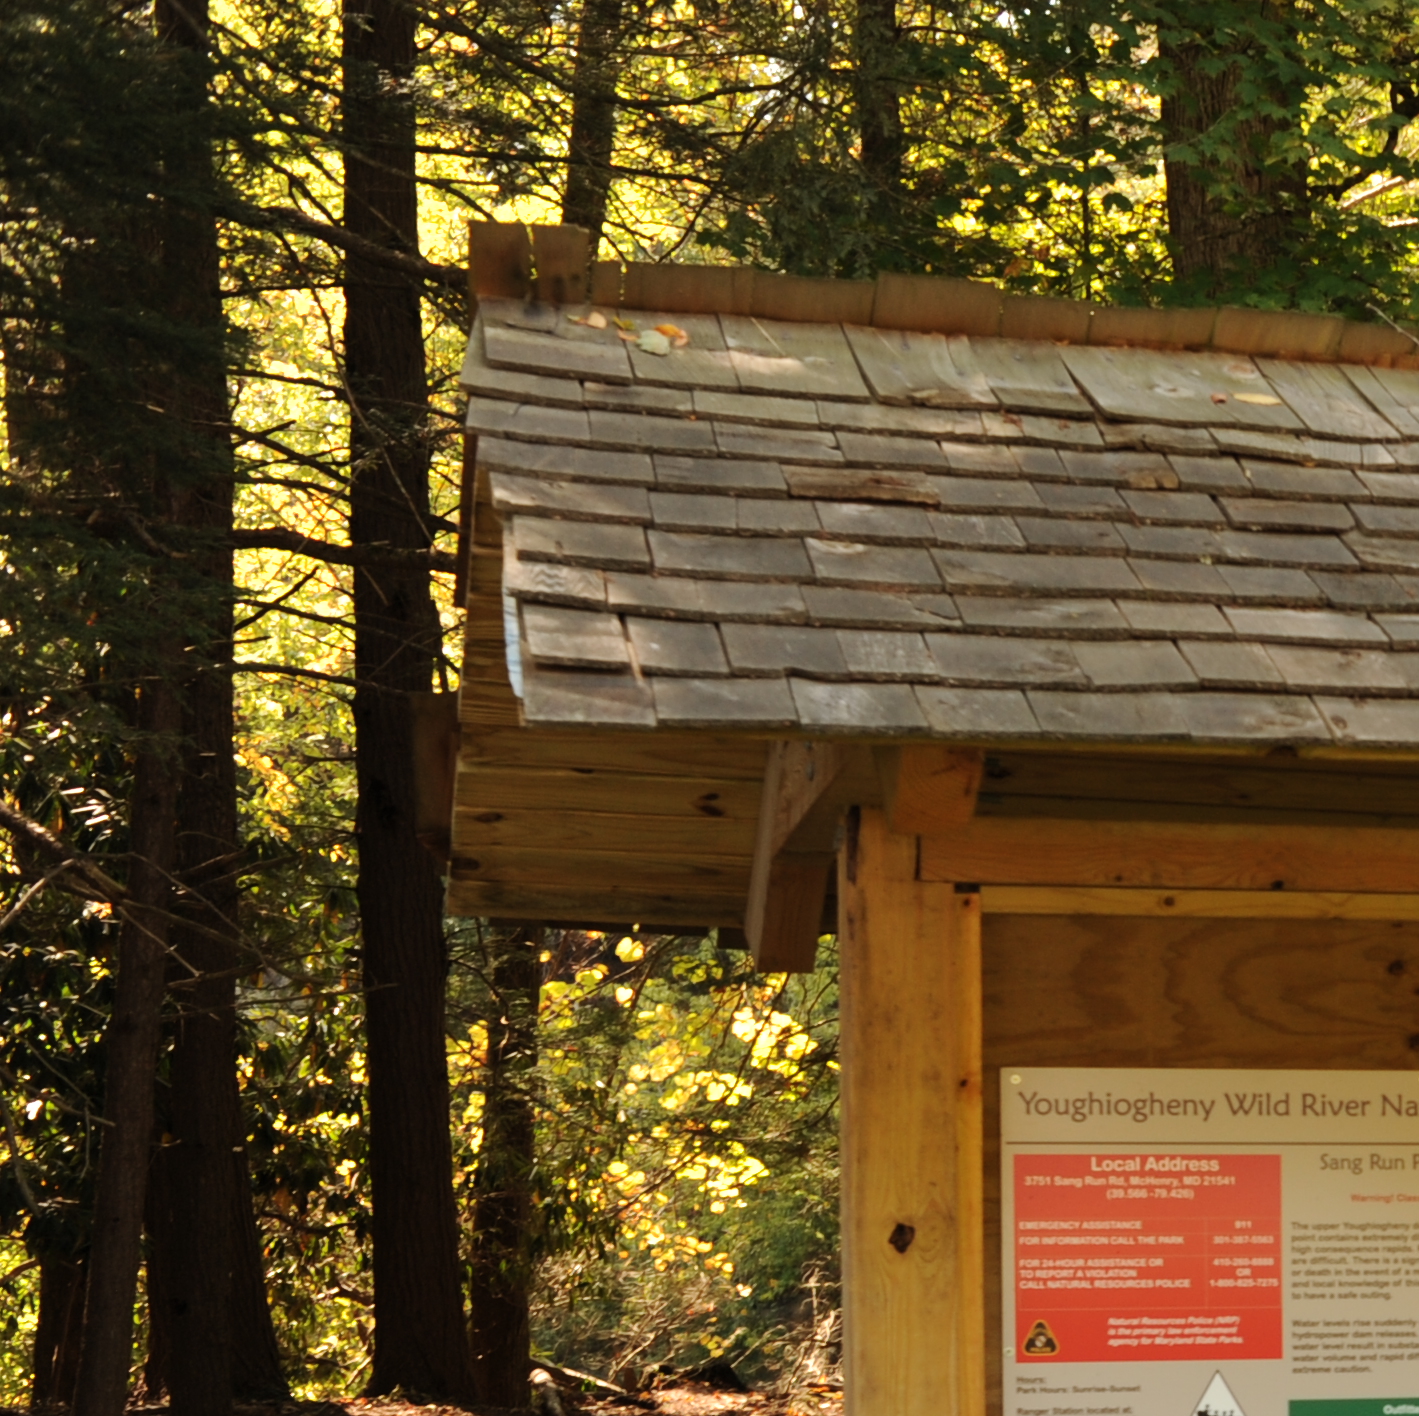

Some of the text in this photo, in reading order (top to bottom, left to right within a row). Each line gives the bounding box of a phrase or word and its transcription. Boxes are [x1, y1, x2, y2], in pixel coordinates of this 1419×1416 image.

[1017, 1091, 1216, 1123] Youghiogheny
[1223, 1092, 1291, 1117] Wild
[1301, 1093, 1371, 1117] River
[1090, 1155, 1220, 1172] Local Address
[1319, 1153, 1364, 1175] Sang
[1369, 1153, 1405, 1171] Run
[1024, 1175, 1236, 1187] 3751 Sang Run Rd, McHenry, MD 21541
[1350, 1194, 1394, 1203] Warning!
[1018, 1220, 1143, 1230] EMERGENCY ASSISTANCE
[1018, 1235, 1184, 1245] FOR INFORMATION CALL THE PARK
[1019, 1258, 1164, 1268] FOR 24-HOUR ASSISTANCE OR
[1019, 1269, 1138, 1279] TO REPORT A VIOLATION
[1019, 1279, 1191, 1289] CALL NATURAL RESOURCES POLICE
